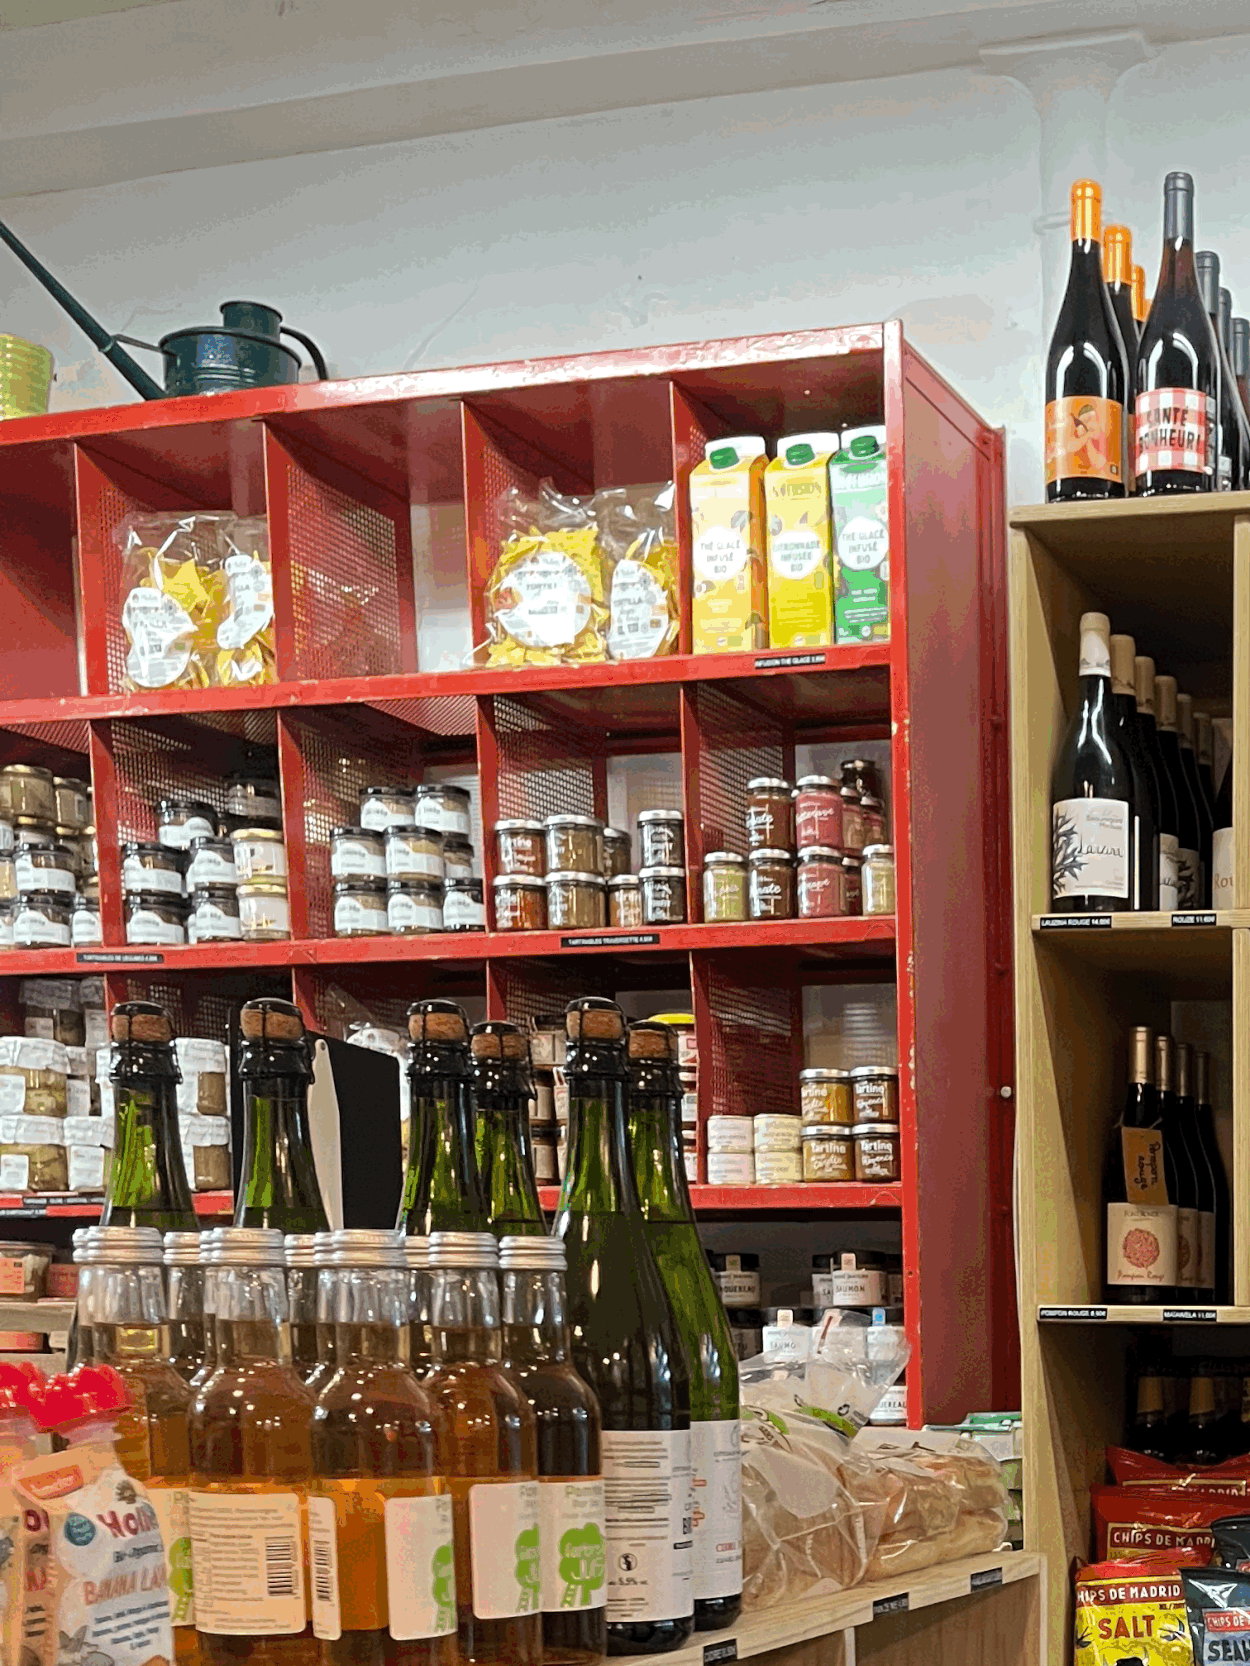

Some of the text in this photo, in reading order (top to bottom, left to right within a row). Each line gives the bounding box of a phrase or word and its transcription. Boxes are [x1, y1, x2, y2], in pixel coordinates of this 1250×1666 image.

[1113, 1531, 1172, 1546] CHIPS DE
[1109, 1585, 1181, 1600] DE MADRID
[1098, 1616, 1156, 1639] SALT
